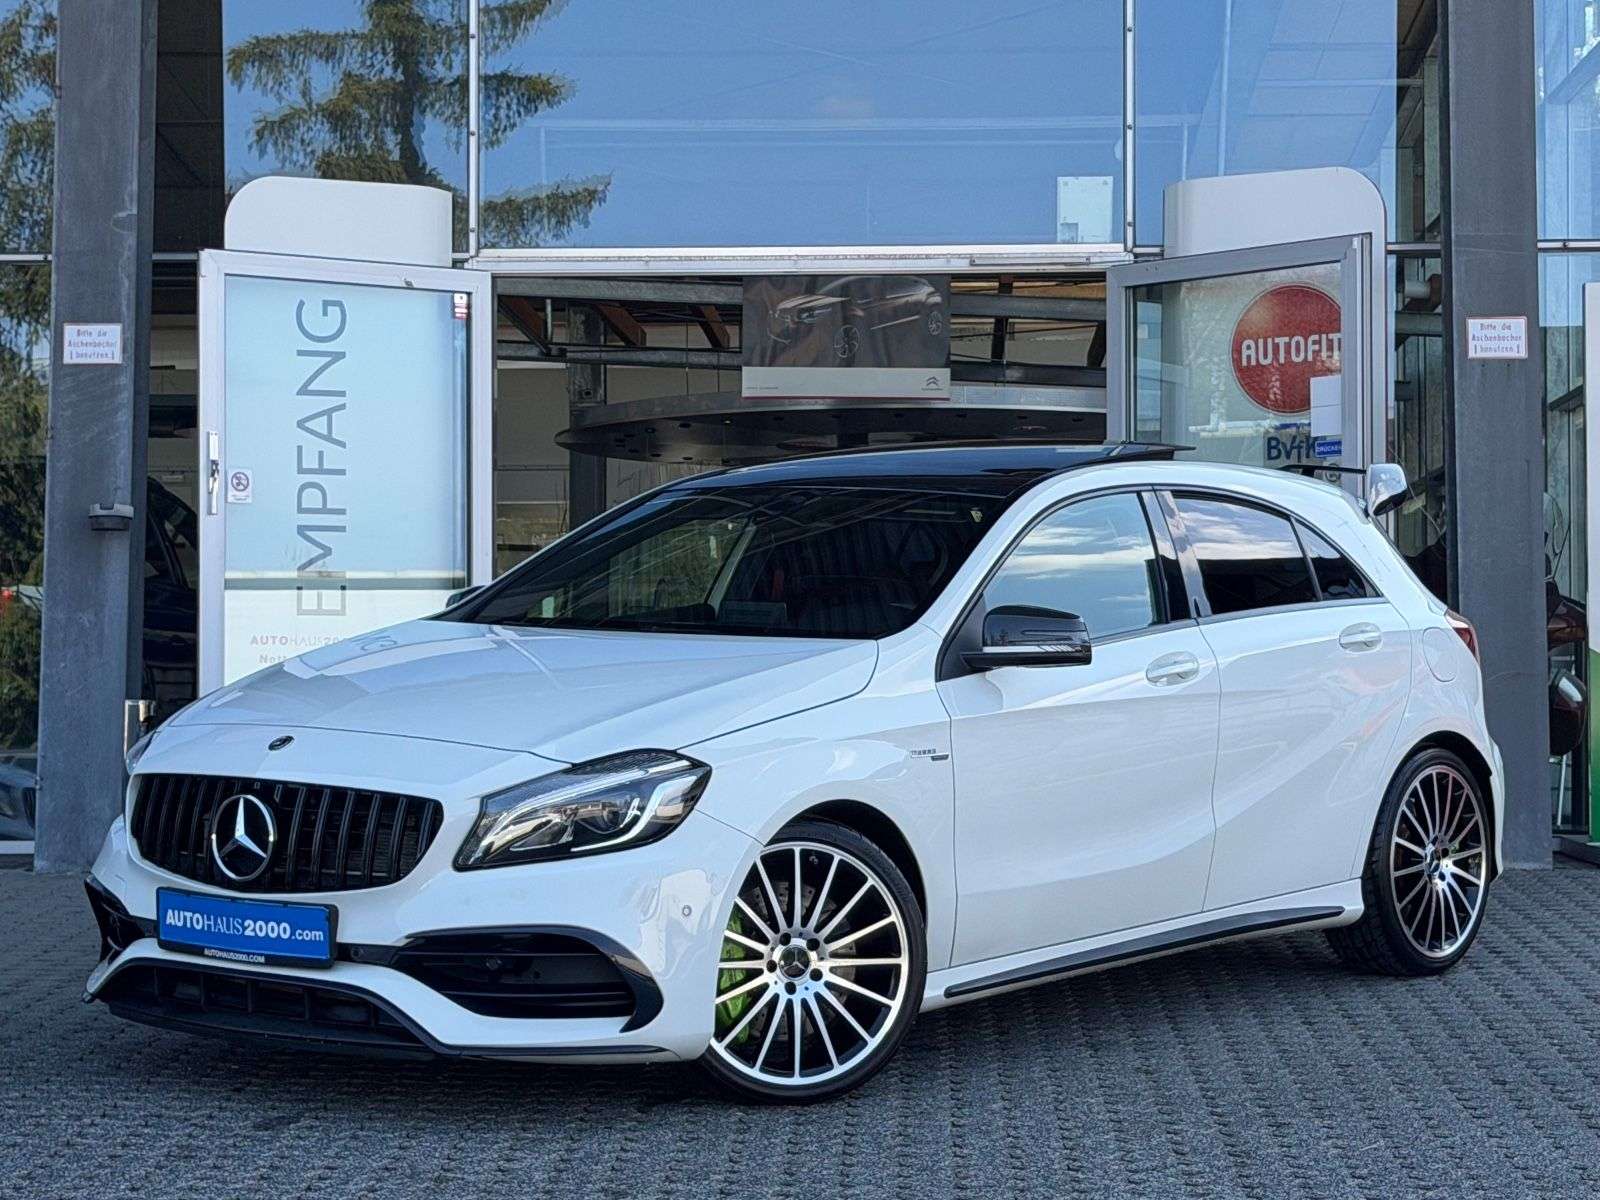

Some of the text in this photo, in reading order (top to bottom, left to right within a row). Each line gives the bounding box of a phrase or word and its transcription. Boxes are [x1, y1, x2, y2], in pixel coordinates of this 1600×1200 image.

[1241, 333, 1341, 367] AUTOFIT
[296, 299, 346, 616] EMPFANG
[165, 908, 324, 942] AUTOHAUS2000.com
